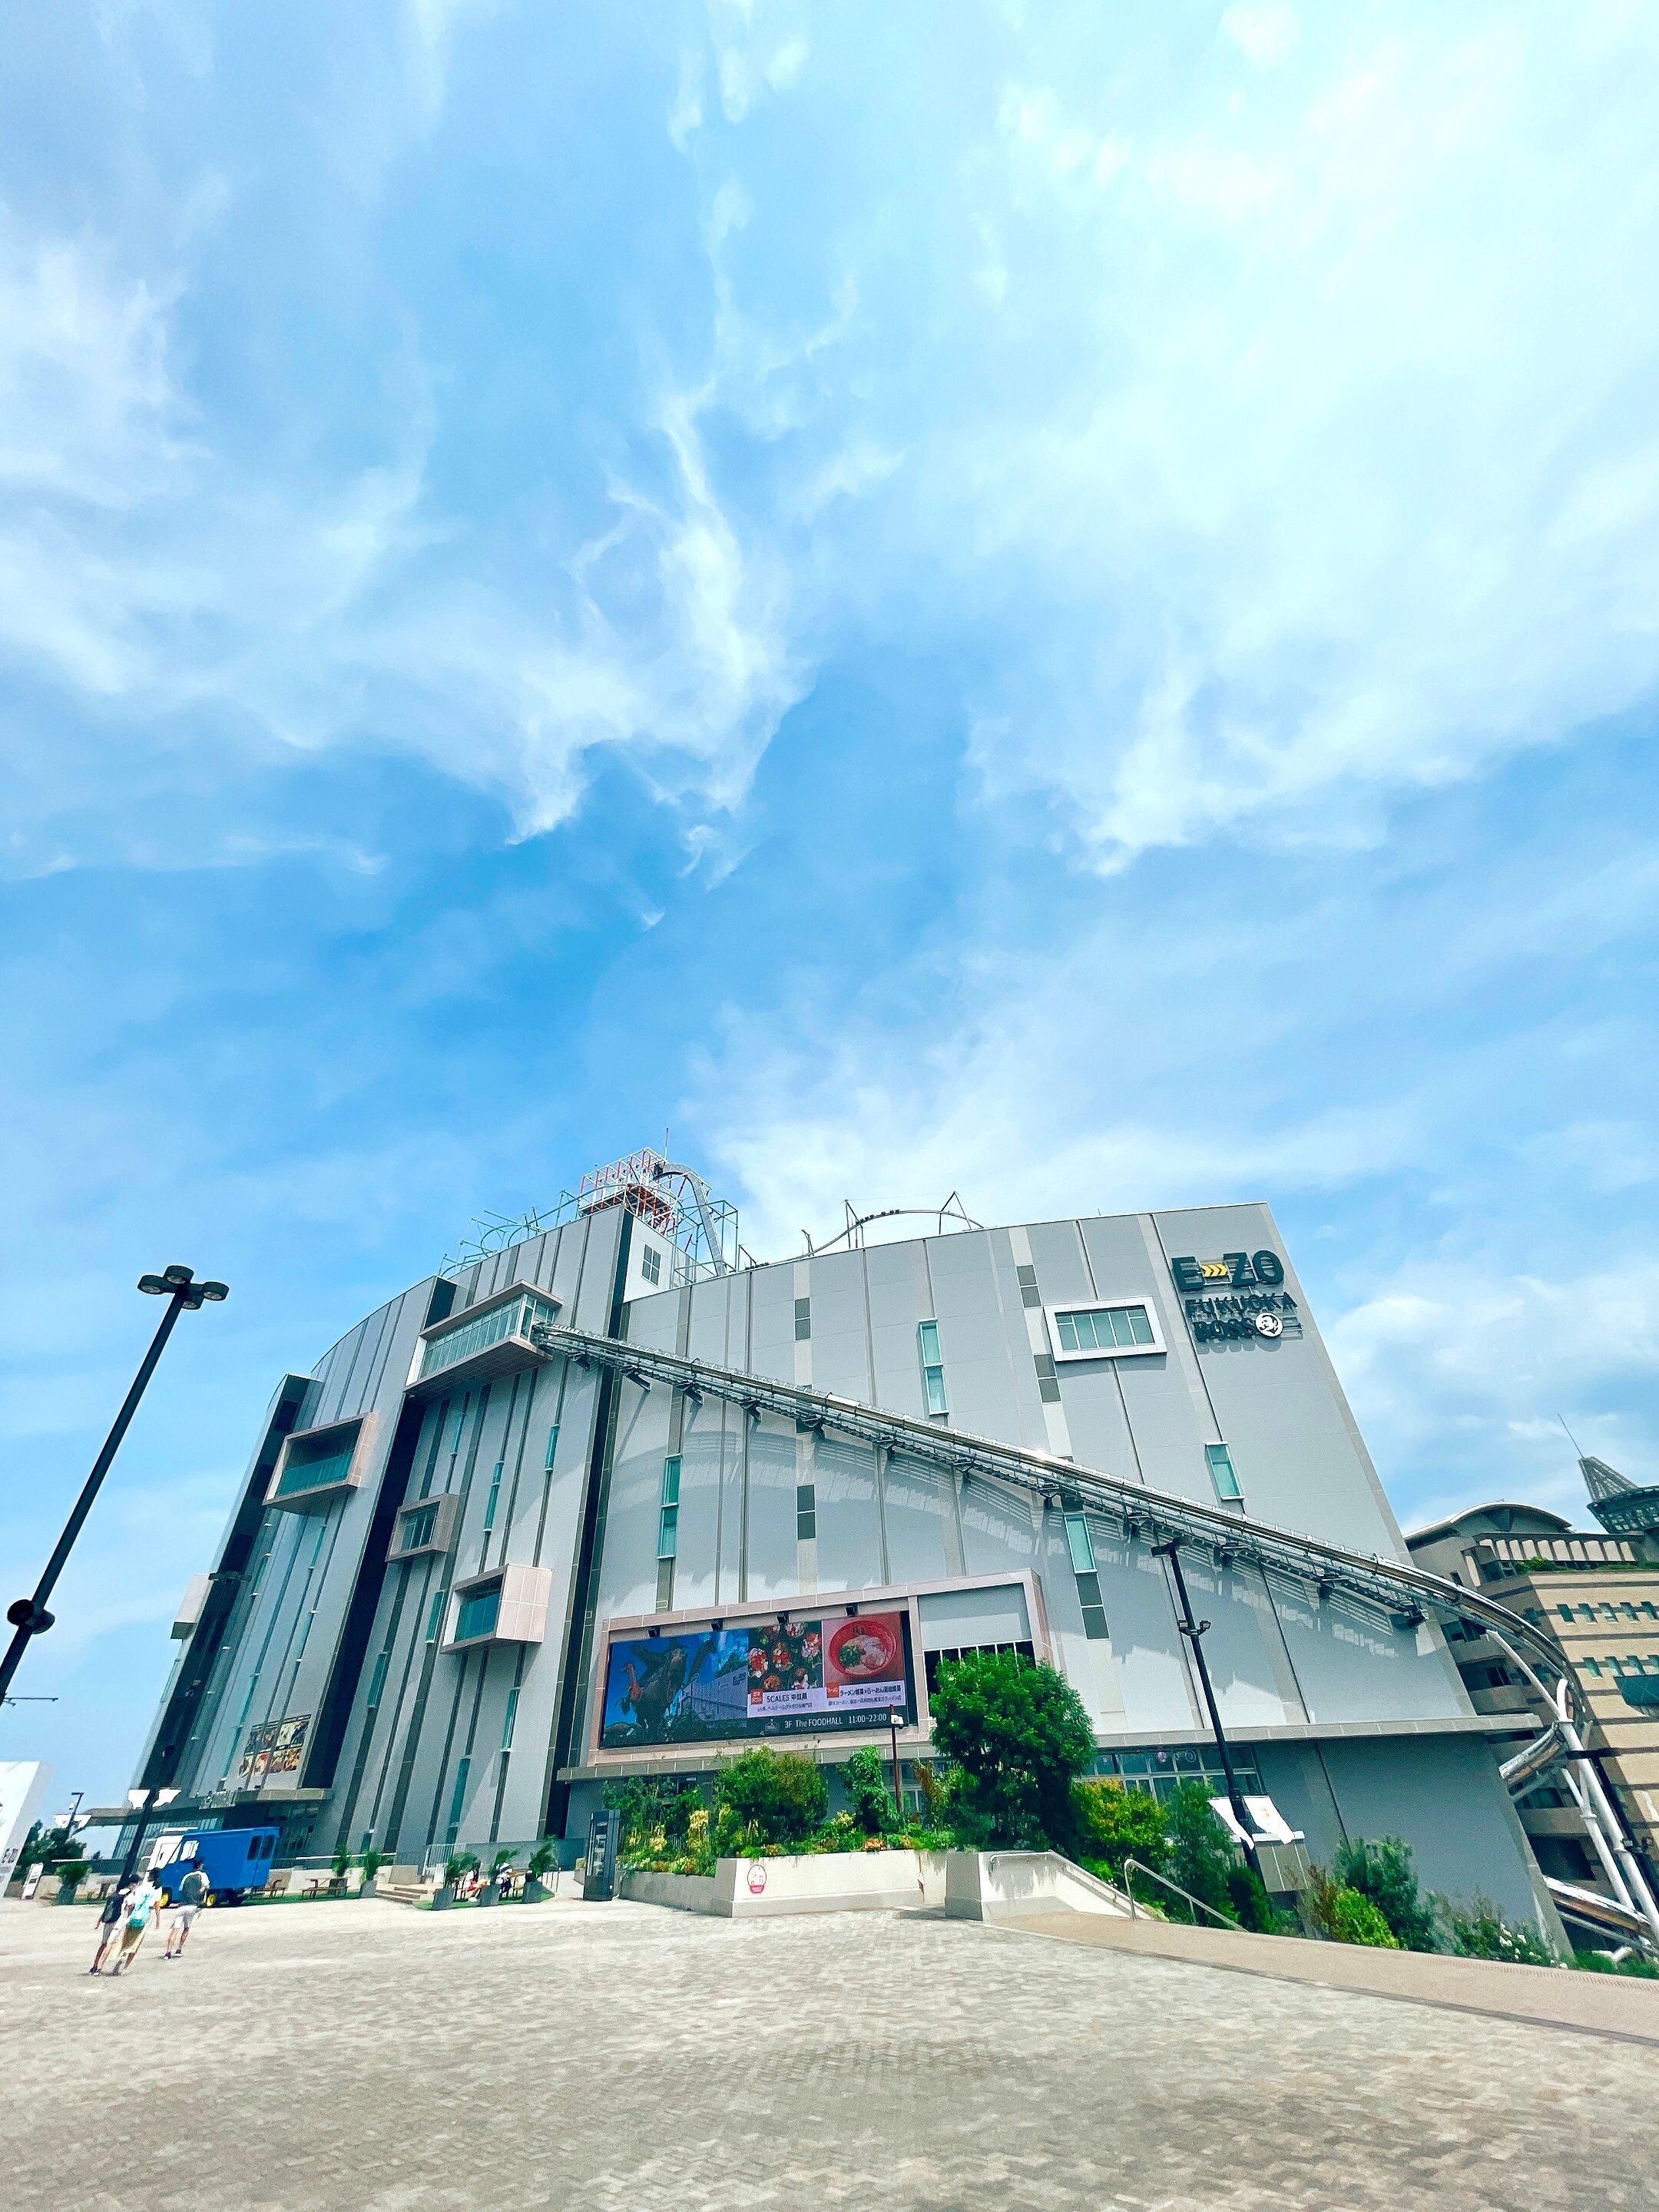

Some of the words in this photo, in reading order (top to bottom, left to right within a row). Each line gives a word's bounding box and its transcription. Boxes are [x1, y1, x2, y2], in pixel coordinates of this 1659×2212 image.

[1185, 1292, 1298, 1315] FUKUOKA
[1194, 1317, 1258, 1342] BOSS
[767, 1694, 790, 1704] SCALES
[795, 1719, 807, 1727] The
[808, 1717, 843, 1727] FOODHALL
